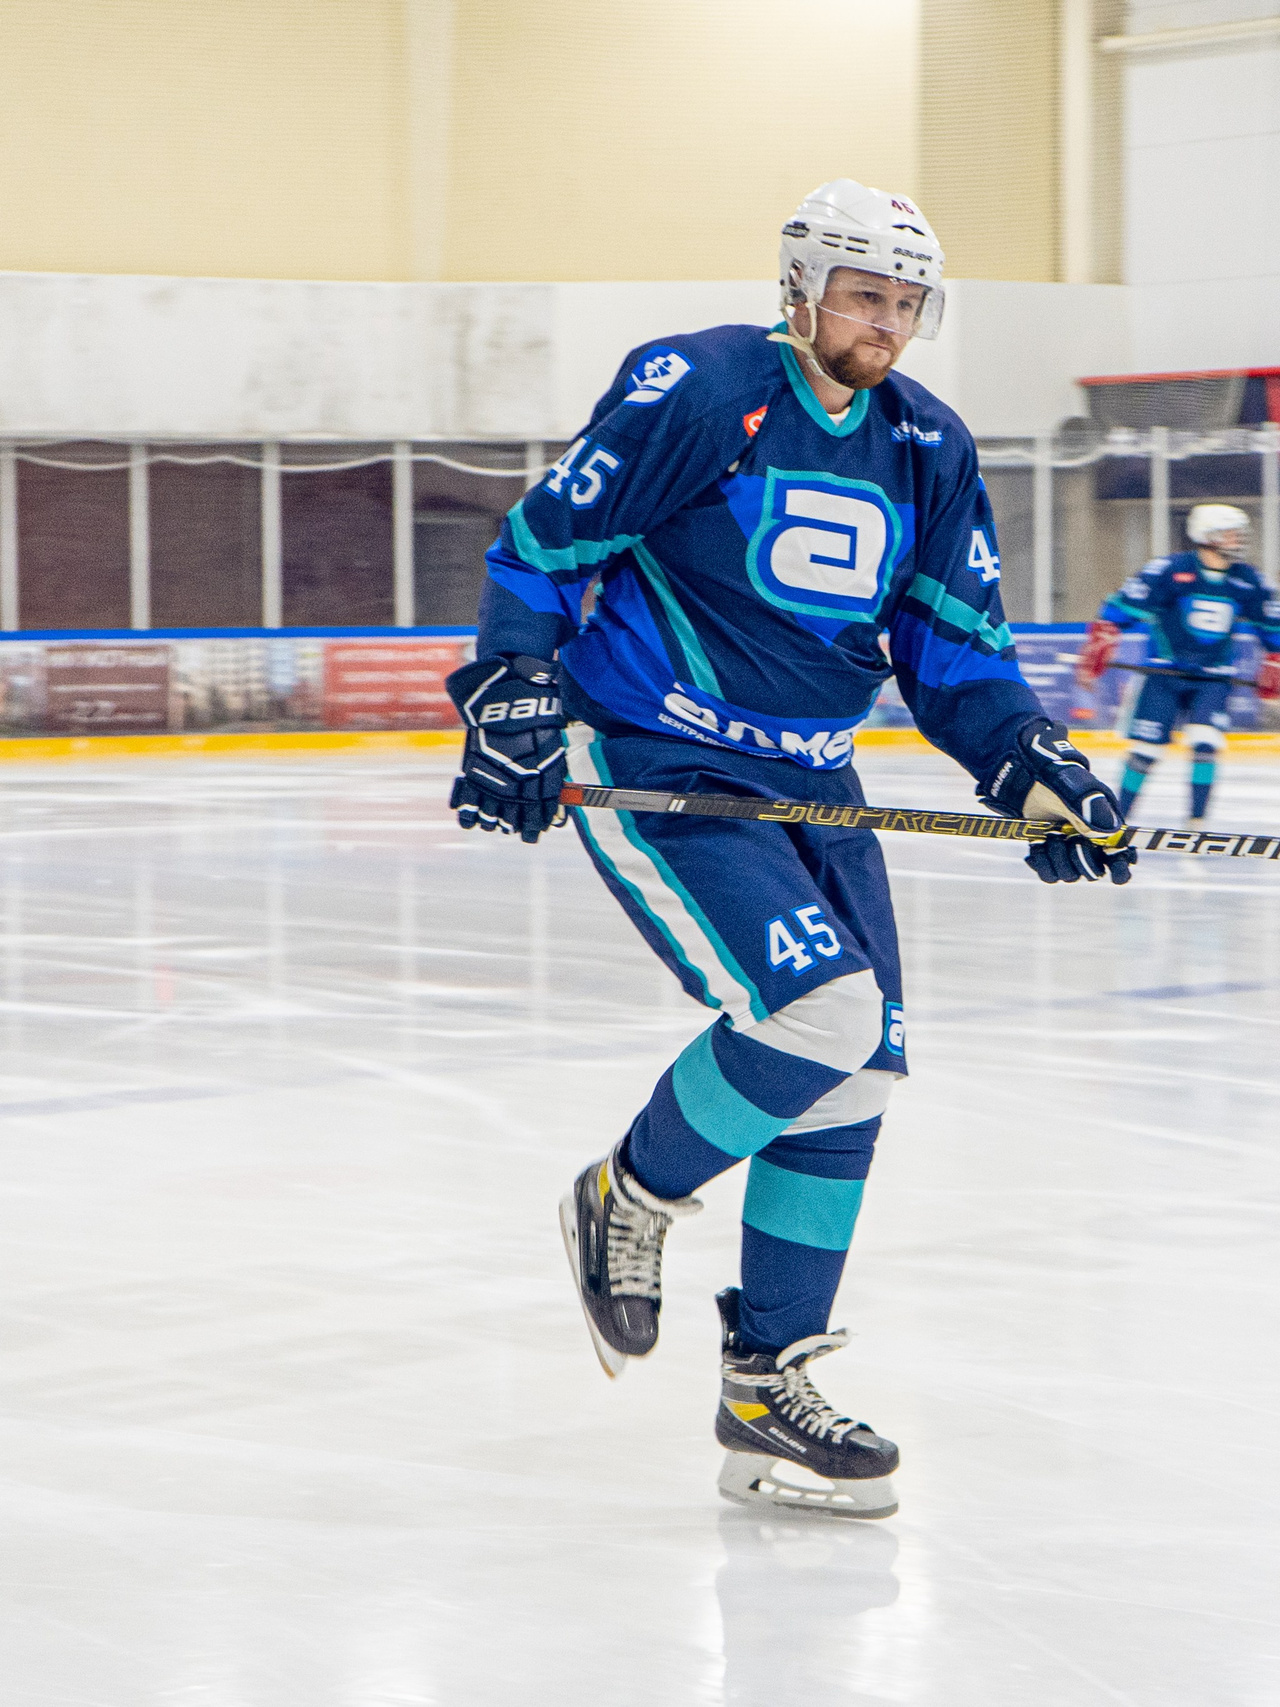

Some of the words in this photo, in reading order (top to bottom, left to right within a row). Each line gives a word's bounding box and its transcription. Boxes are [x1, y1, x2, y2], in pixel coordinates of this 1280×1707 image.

[892, 246, 933, 263] BAUER
[543, 435, 624, 509] 45
[967, 528, 1001, 584] 4
[478, 697, 563, 724] BAU
[758, 801, 1051, 840] SUPREME
[766, 904, 843, 974] 45
[768, 1426, 807, 1454] BAUER
